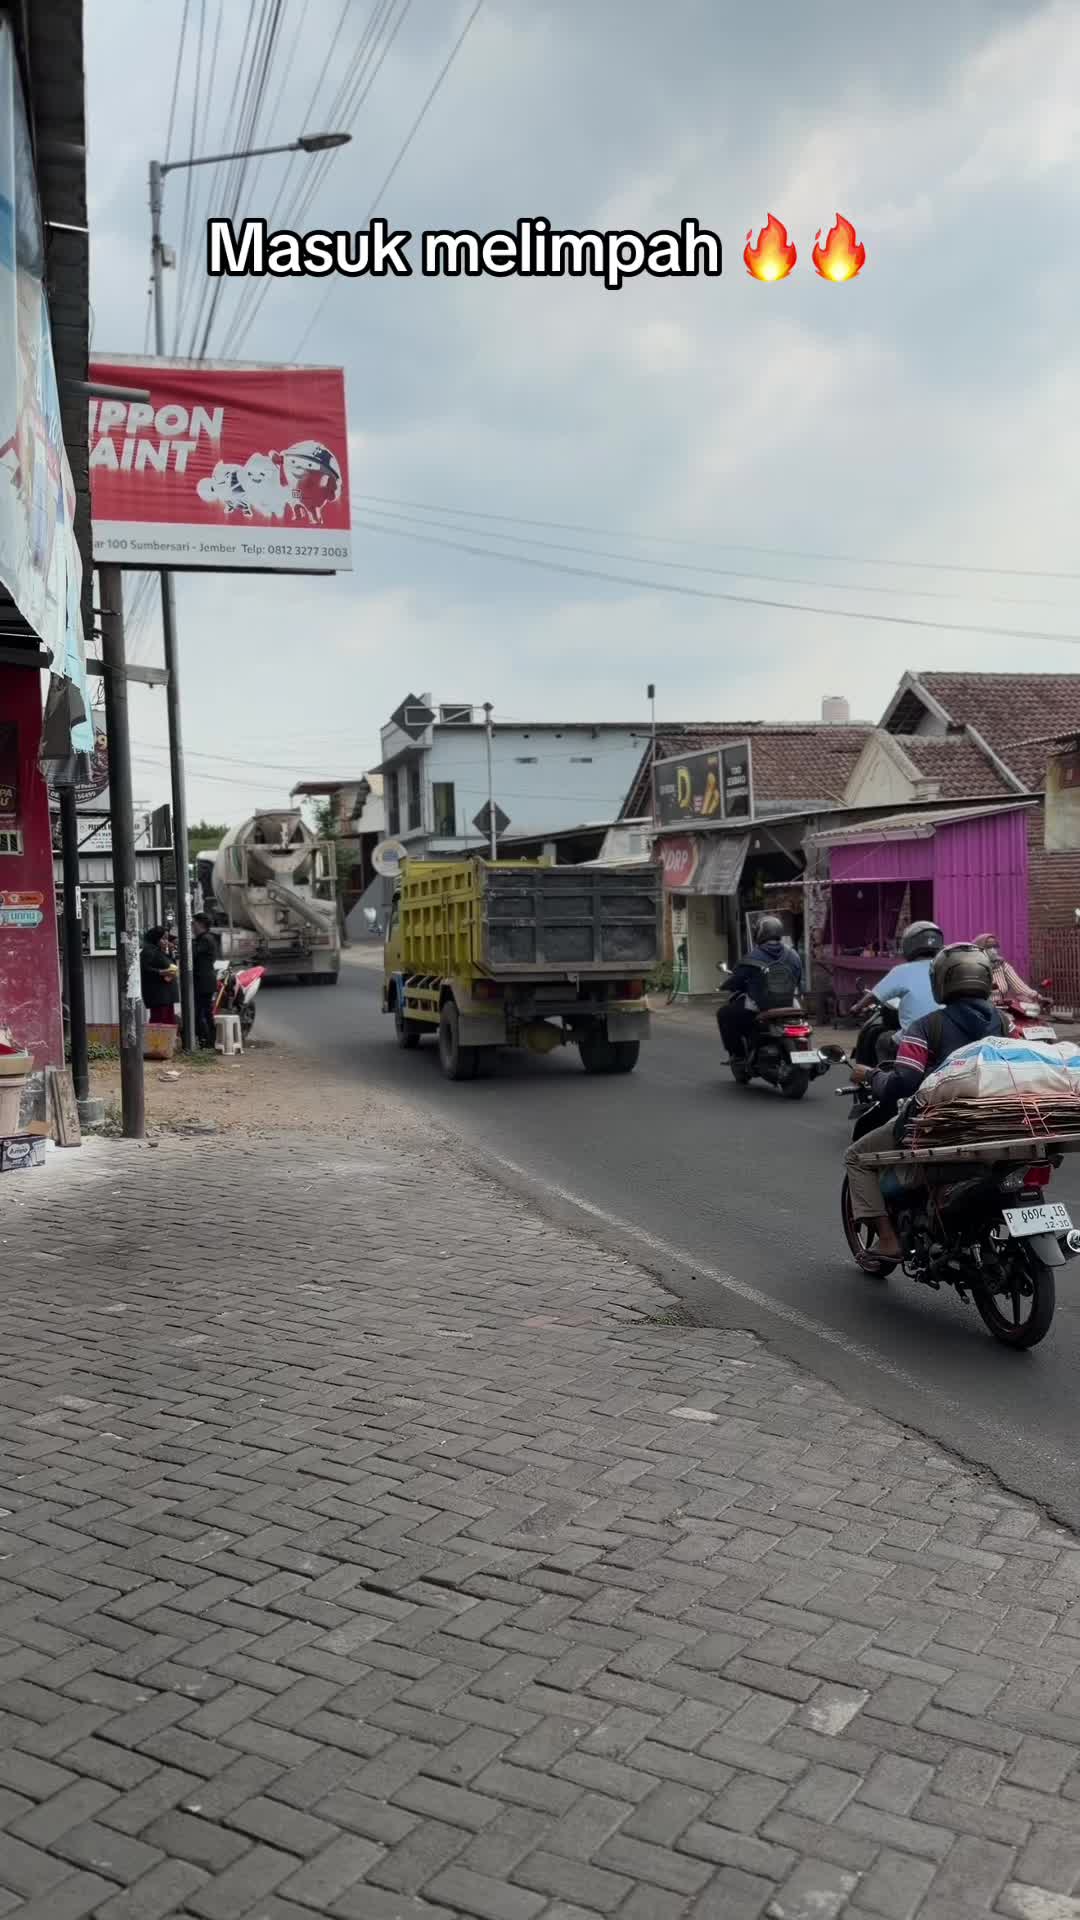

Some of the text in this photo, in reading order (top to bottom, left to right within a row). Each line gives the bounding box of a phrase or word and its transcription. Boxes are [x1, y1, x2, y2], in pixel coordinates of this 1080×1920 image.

[88, 436, 198, 474] AINT
[107, 538, 128, 550] 100
[129, 539, 190, 552] Sumbersari
[199, 541, 236, 553] Jember
[241, 543, 265, 557] Telp:
[267, 544, 292, 556] 0812
[295, 546, 319, 557] 3277
[321, 547, 348, 558] 3003
[1006, 1212, 1013, 1223] P
